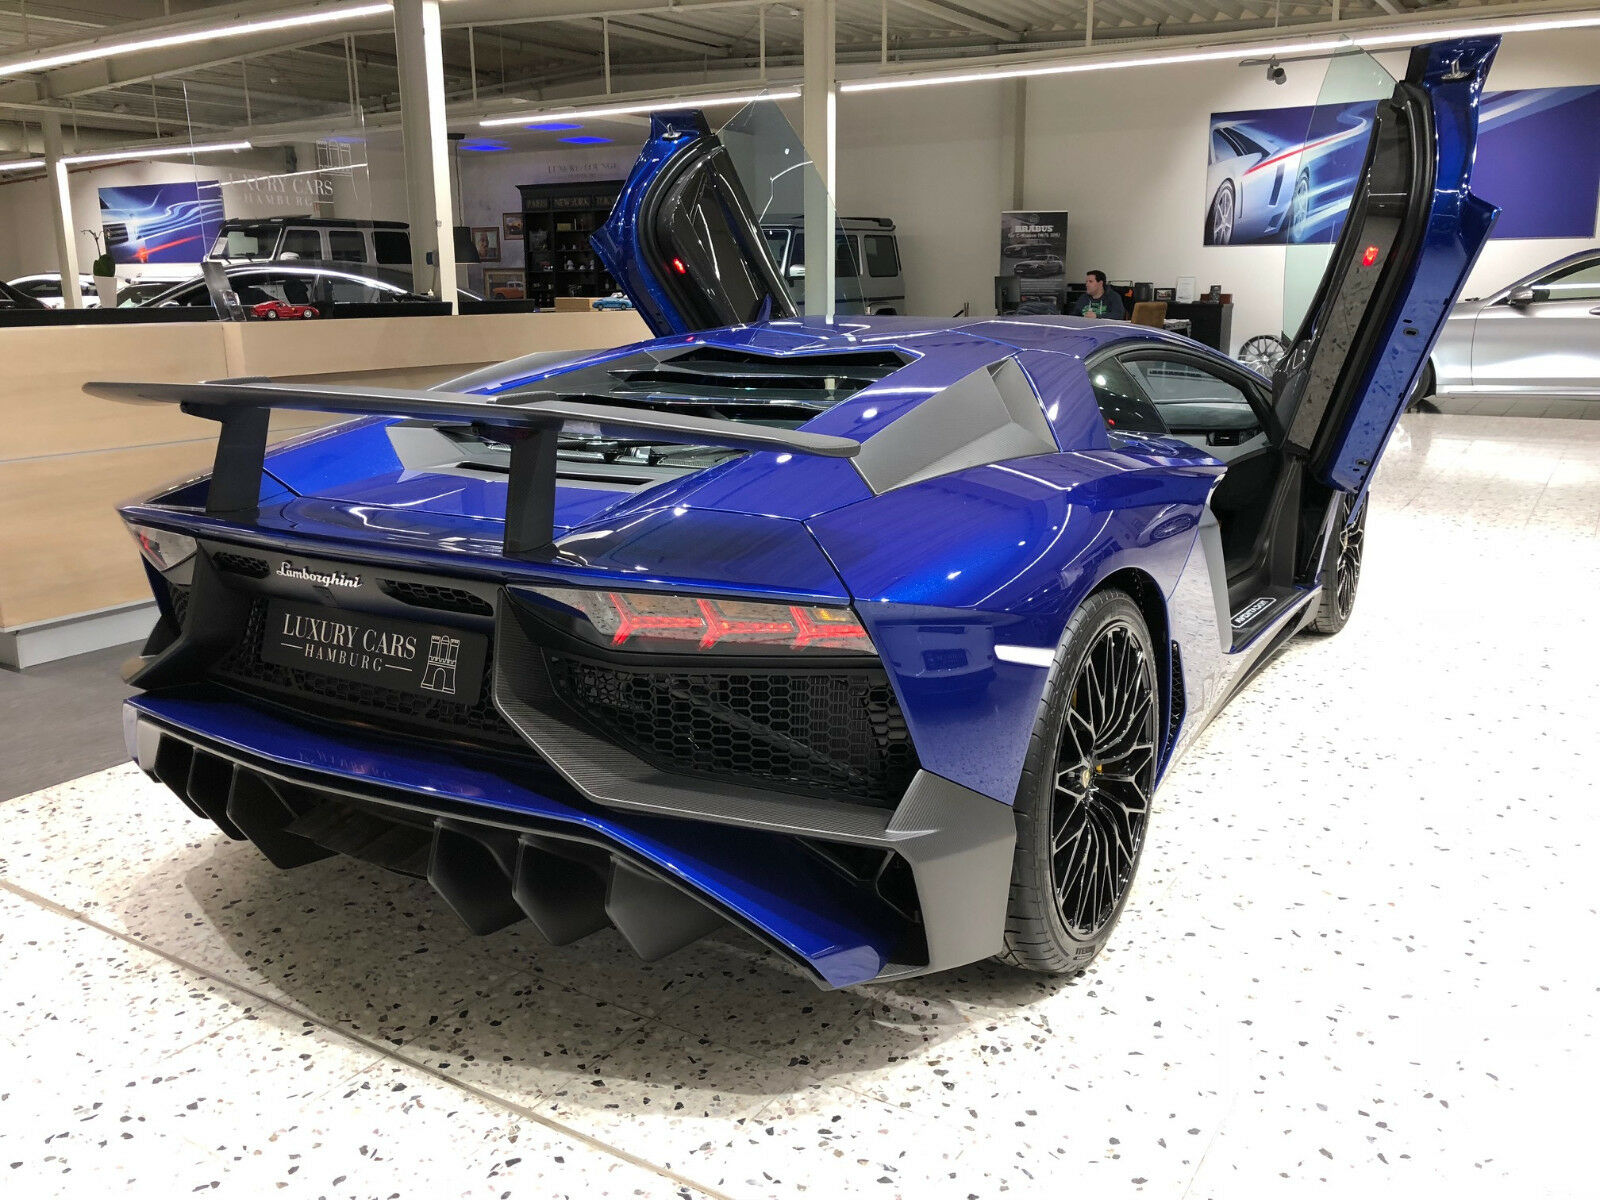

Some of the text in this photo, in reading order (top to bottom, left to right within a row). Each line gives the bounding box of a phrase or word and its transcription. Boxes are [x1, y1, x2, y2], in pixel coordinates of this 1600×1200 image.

[292, 177, 334, 196] CARS
[1014, 225, 1054, 233] BRABUS
[276, 561, 362, 588] Lamborghini
[282, 613, 417, 660] LUXURY CARS
[304, 643, 383, 672] HAMBURG
